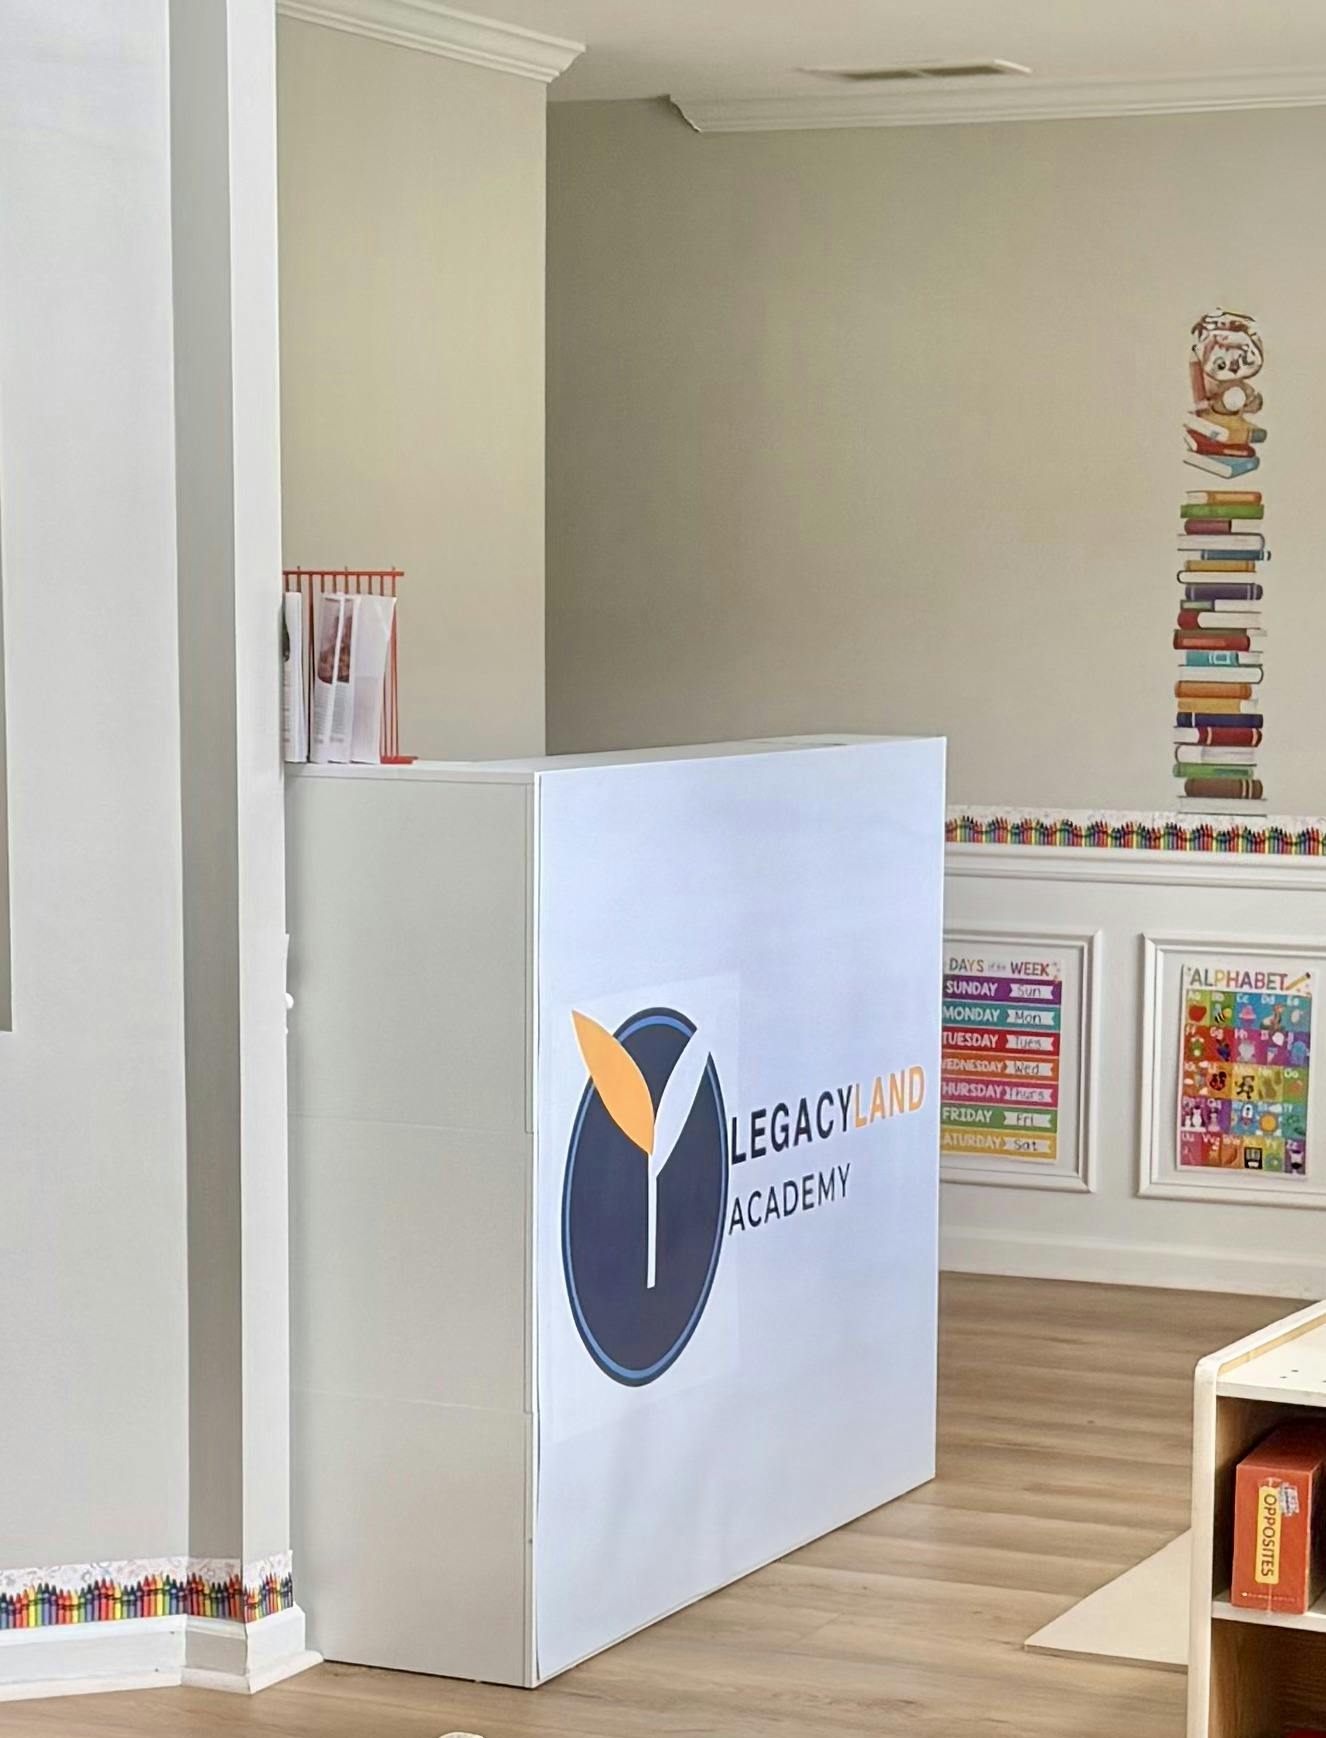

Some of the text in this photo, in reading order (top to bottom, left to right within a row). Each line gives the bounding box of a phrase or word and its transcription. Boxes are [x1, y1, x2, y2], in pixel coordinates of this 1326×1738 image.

[949, 957, 984, 973] DAYS
[1011, 961, 1050, 977] WEEK
[946, 980, 1041, 996] SUNDAY Sun
[1190, 968, 1288, 990] ALPHABET
[943, 1006, 1041, 1024] MONDAY Mon
[943, 1032, 998, 1049] TUESDAY
[1014, 1061, 1040, 1075] Wed
[942, 1082, 1003, 1099] HURSDAY
[731, 1064, 925, 1165] LEGACYLAND
[943, 1107, 1035, 1126] FRIDAY Fri
[943, 1132, 1037, 1151] ATURDAY Sat
[728, 1163, 850, 1236] ACADEMY
[1261, 1493, 1277, 1577] OPPOSITES
